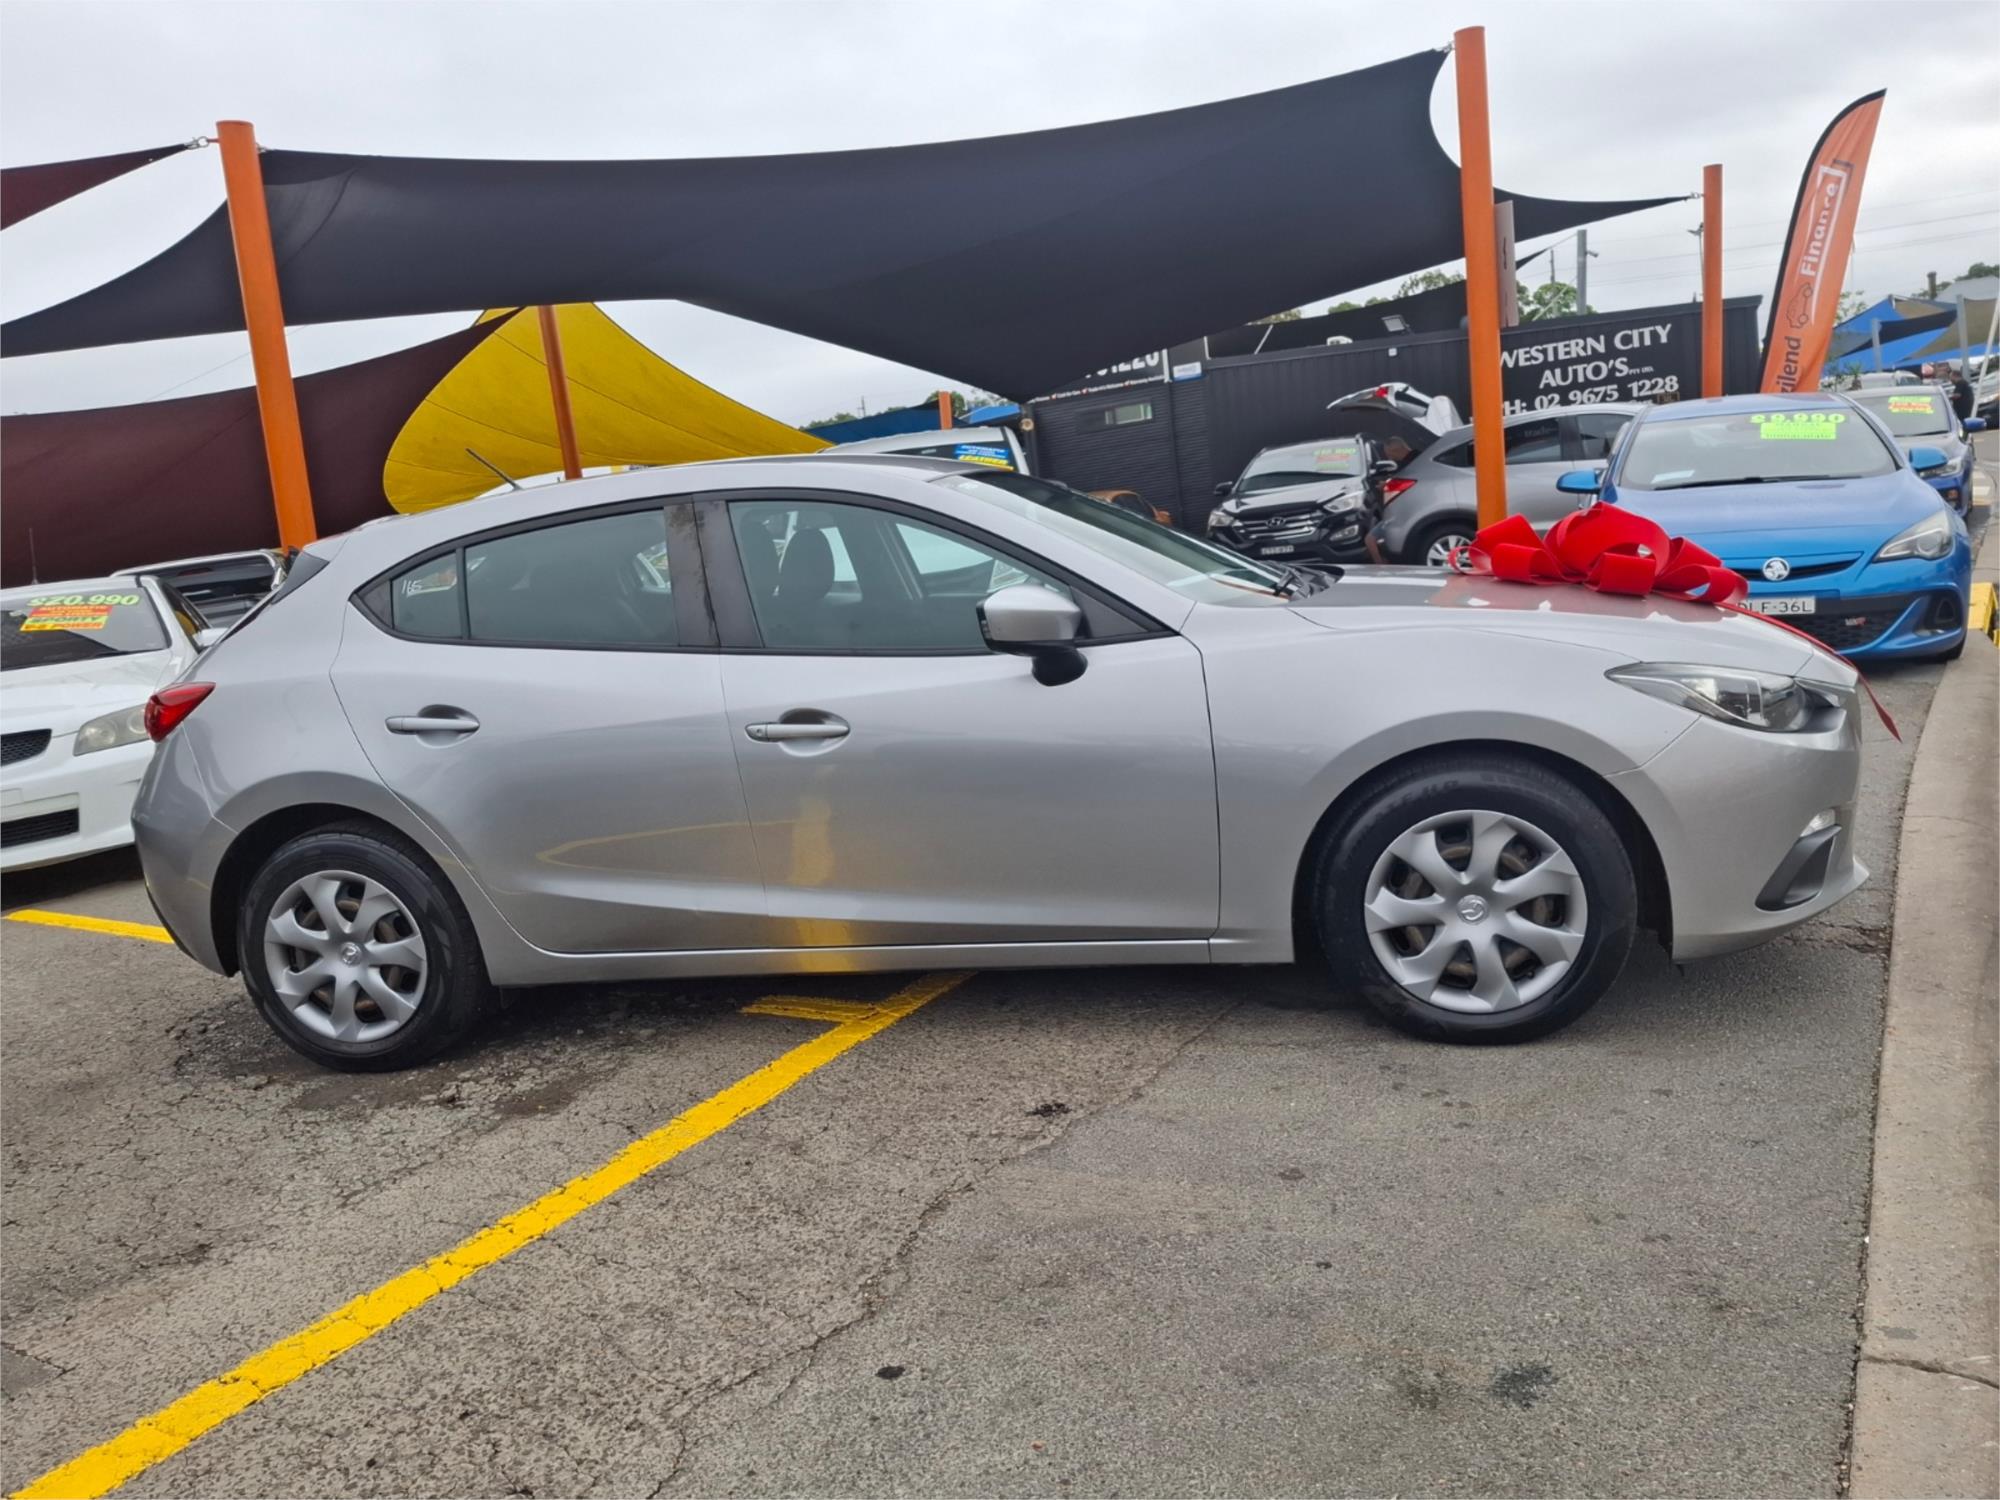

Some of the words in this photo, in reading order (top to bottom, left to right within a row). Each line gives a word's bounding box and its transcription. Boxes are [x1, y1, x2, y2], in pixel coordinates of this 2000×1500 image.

[1500, 334, 1605, 369] WESTERN
[1614, 323, 1672, 350] CITY
[1775, 335, 1801, 393] zilend
[1534, 393, 1561, 411] 02
[1568, 384, 1619, 405] 9675
[1627, 375, 1679, 398] 1228
[1539, 357, 1629, 389] AUTO'S
